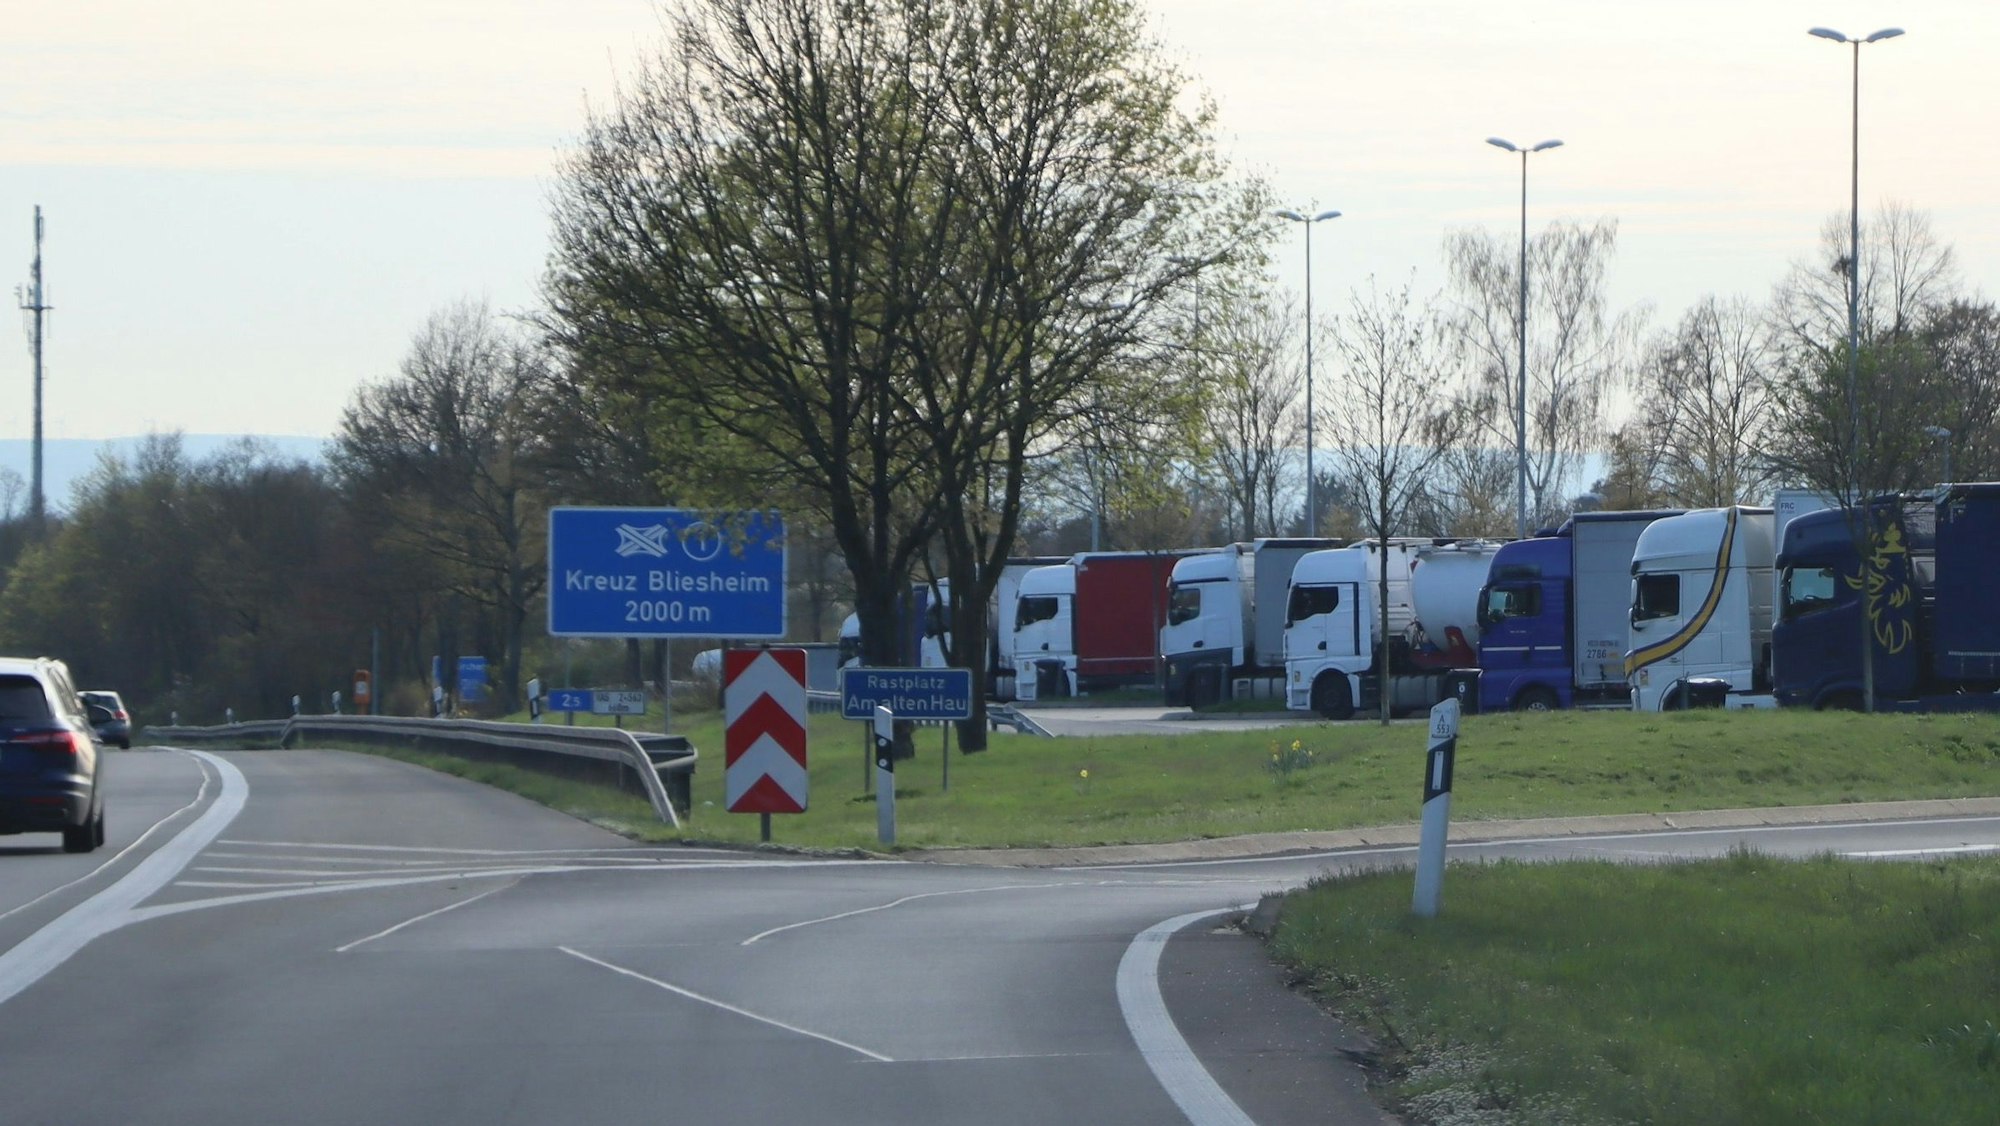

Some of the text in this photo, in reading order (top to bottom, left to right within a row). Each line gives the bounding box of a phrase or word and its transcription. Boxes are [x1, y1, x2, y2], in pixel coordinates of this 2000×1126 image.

[1780, 502, 1795, 510] FRC
[565, 569, 770, 593] Kreuz Bliesheim
[624, 600, 711, 622] 2000 m
[1586, 649, 1607, 660] 2786
[867, 674, 946, 692] Rastplatz
[846, 693, 967, 711] Am alten Hau
[1436, 724, 1450, 734] 553
